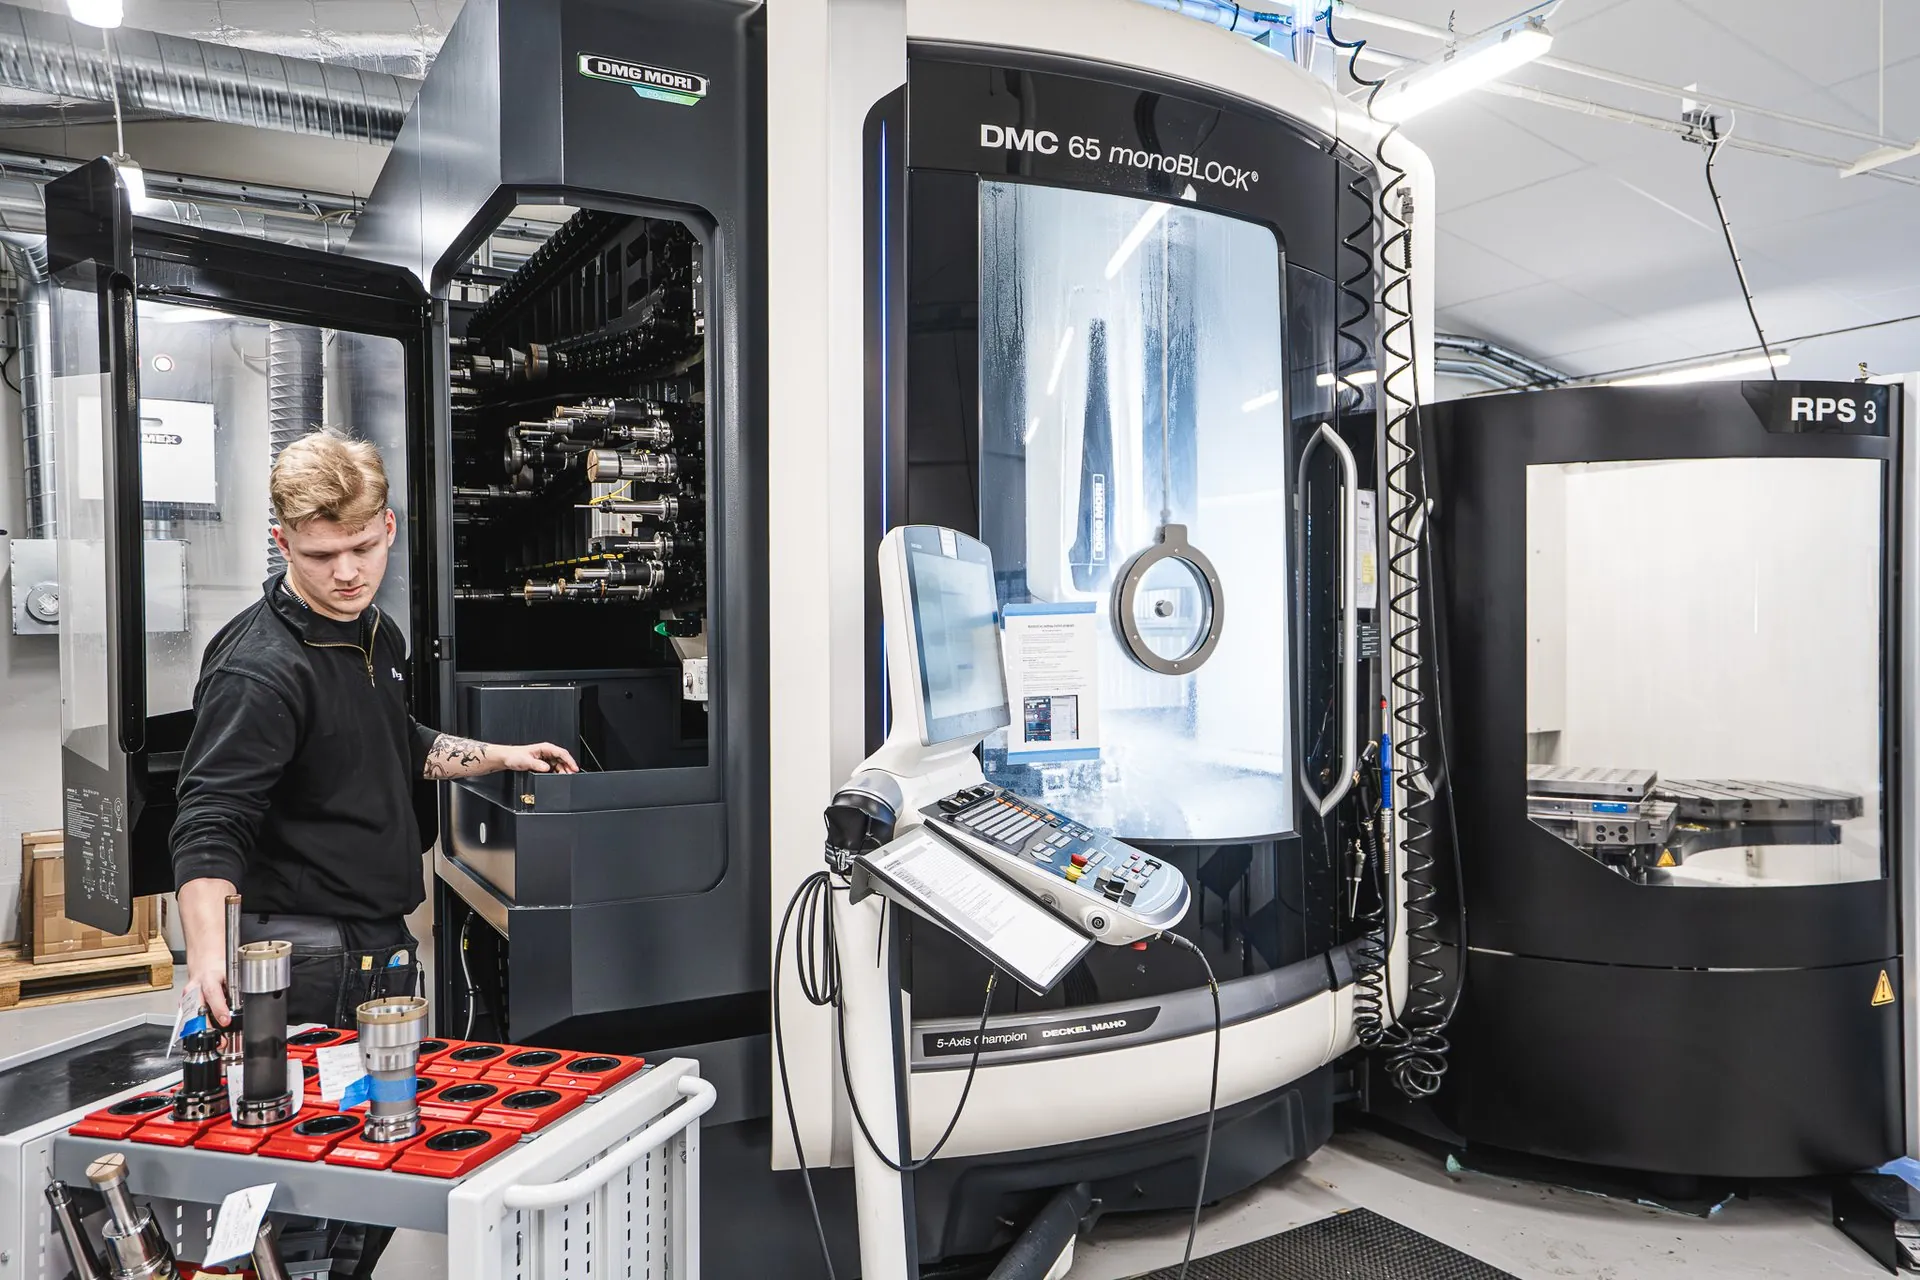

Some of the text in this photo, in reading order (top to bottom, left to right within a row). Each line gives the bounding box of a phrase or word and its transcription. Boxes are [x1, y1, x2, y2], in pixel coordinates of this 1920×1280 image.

[597, 60, 692, 90] DMG MORI
[980, 124, 1059, 154] DMC
[1068, 135, 1102, 161] 65
[1791, 397, 1877, 424] RPS 3
[936, 1036, 971, 1048] 5-Axis
[1042, 1019, 1127, 1038] DECKEL MAHO
